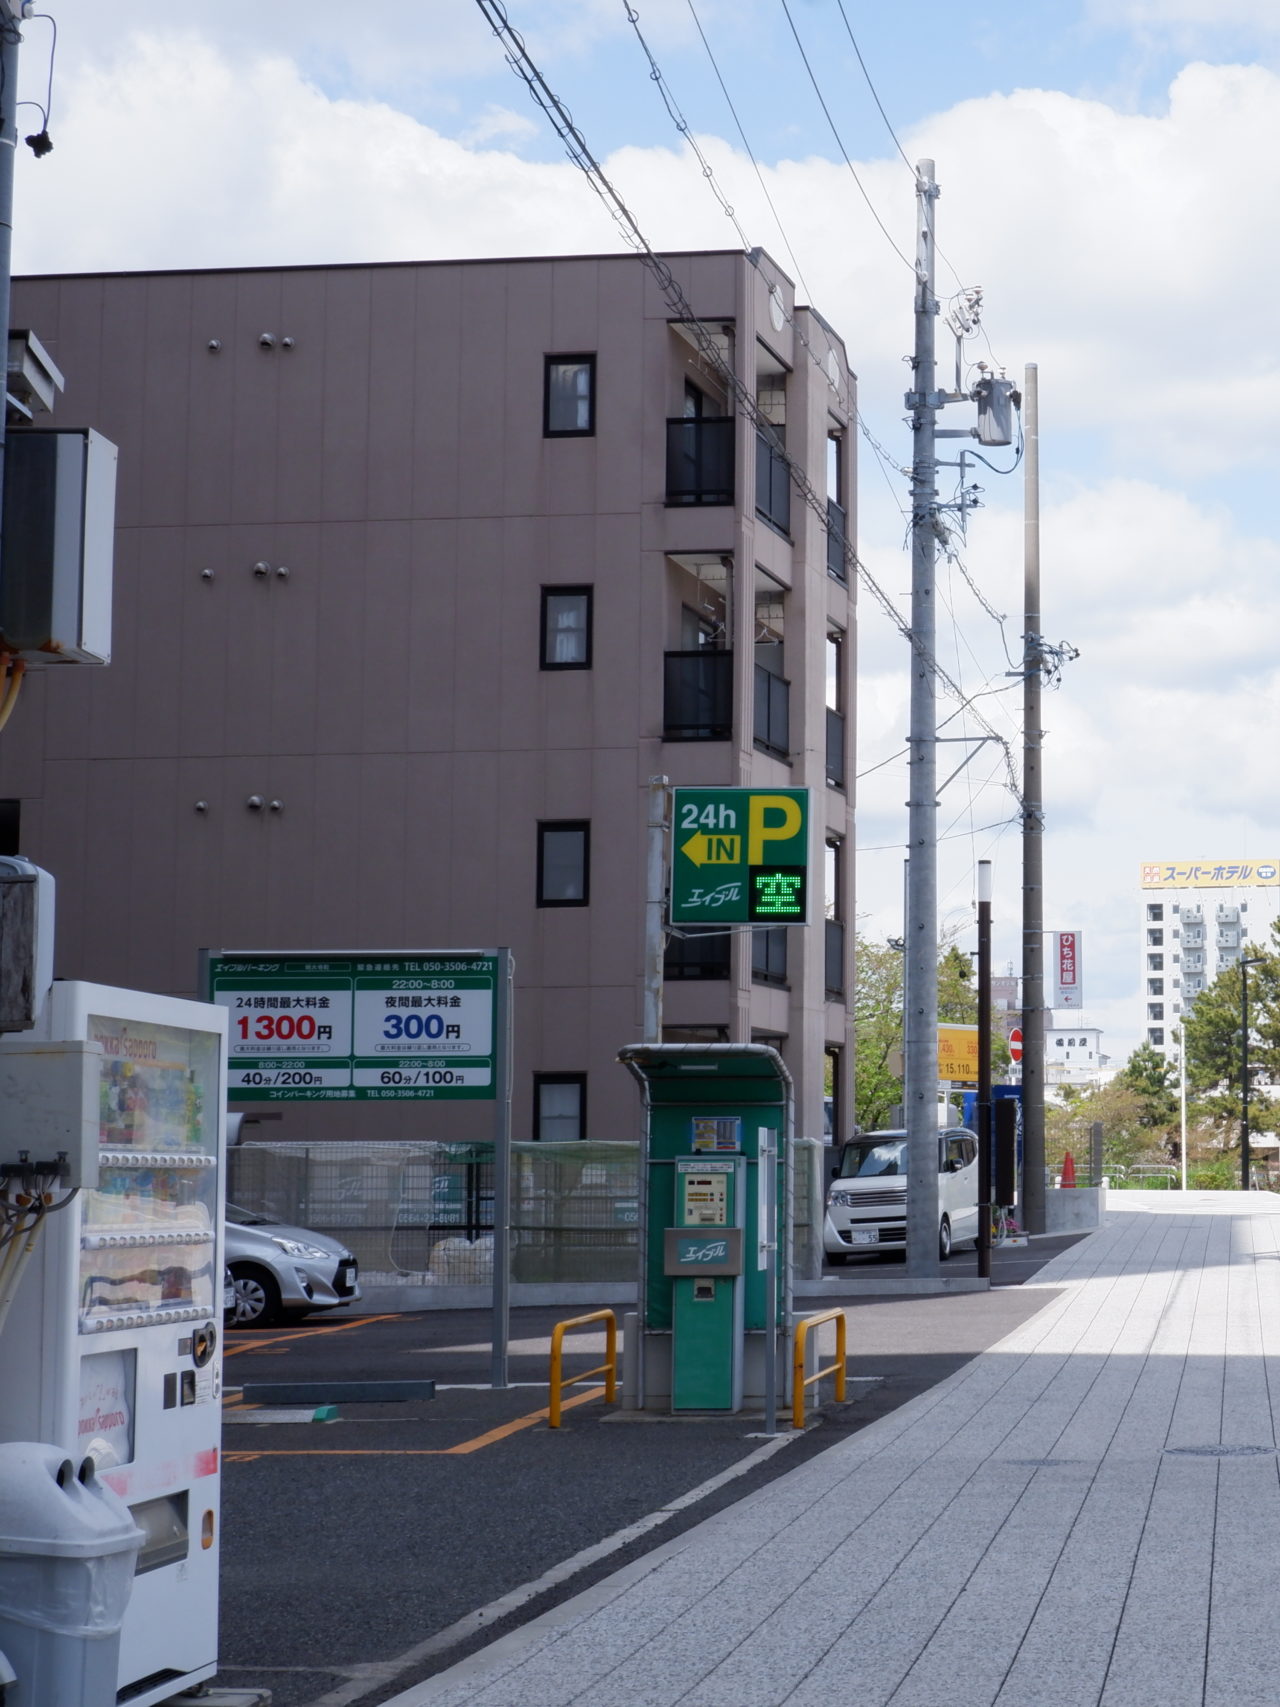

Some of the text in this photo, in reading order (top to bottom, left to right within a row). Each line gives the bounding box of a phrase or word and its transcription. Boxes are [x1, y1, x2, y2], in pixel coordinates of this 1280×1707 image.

[680, 803, 737, 829] 24h
[747, 795, 803, 866] P
[706, 838, 735, 861] IN
[1163, 865, 1253, 881] スーパーホテル
[681, 882, 742, 908] エイブル
[756, 873, 801, 913] 空
[404, 962, 421, 971] TEL
[423, 962, 493, 971] 050-3506-4721
[1061, 934, 1074, 984] ひち花屋
[235, 996, 331, 1009] 24時間最大料金
[384, 995, 462, 1008] 夜間最大料金
[237, 1014, 332, 1040] 1300円
[383, 1013, 461, 1039] 300円
[241, 1071, 323, 1086] 40分/200円
[380, 1070, 464, 1085] 60分/100円
[269, 1090, 356, 1098] コインパーキング用地募集
[680, 1241, 726, 1262] エイブル
